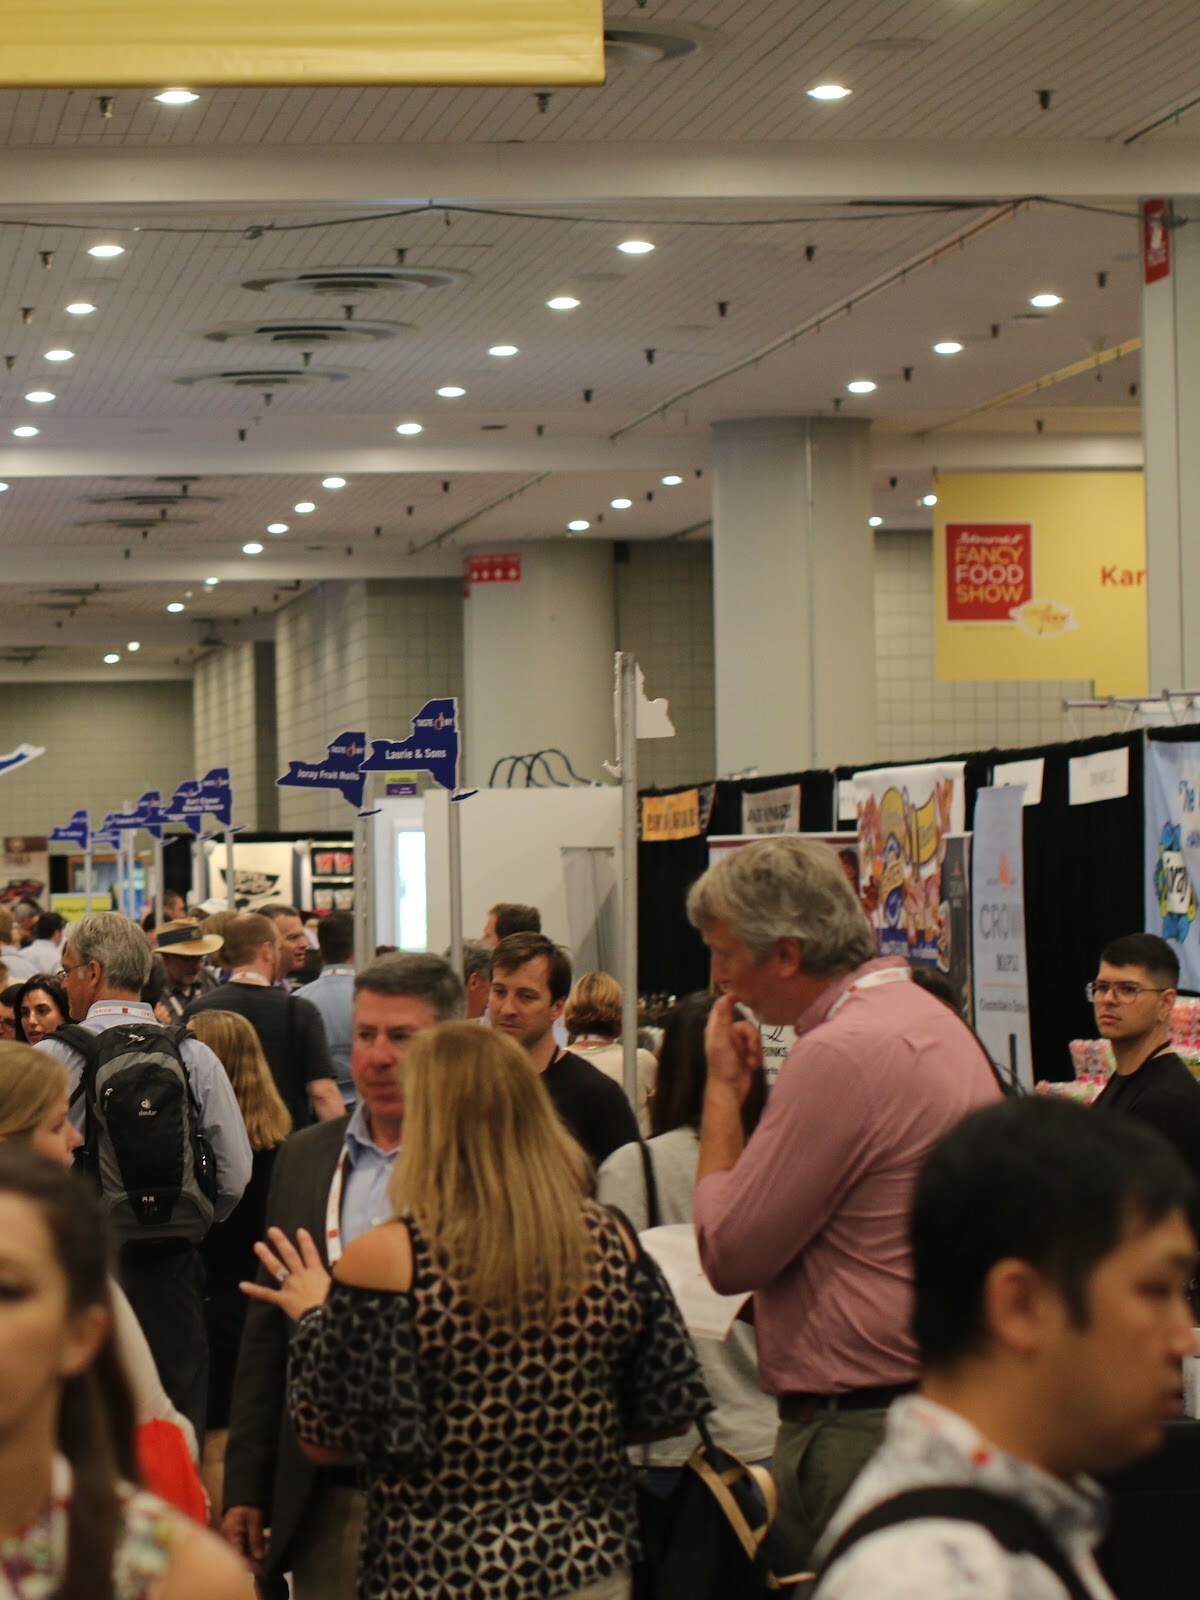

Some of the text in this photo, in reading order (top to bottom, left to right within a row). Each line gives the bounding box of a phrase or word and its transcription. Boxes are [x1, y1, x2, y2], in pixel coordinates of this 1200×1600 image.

[955, 546, 1024, 564] FANCY
[955, 564, 1024, 584] FOOD
[955, 585, 1024, 604] SHOW
[385, 748, 447, 760] Laurie & Sons
[319, 770, 338, 780] Fruit
[339, 770, 360, 781] Rolls
